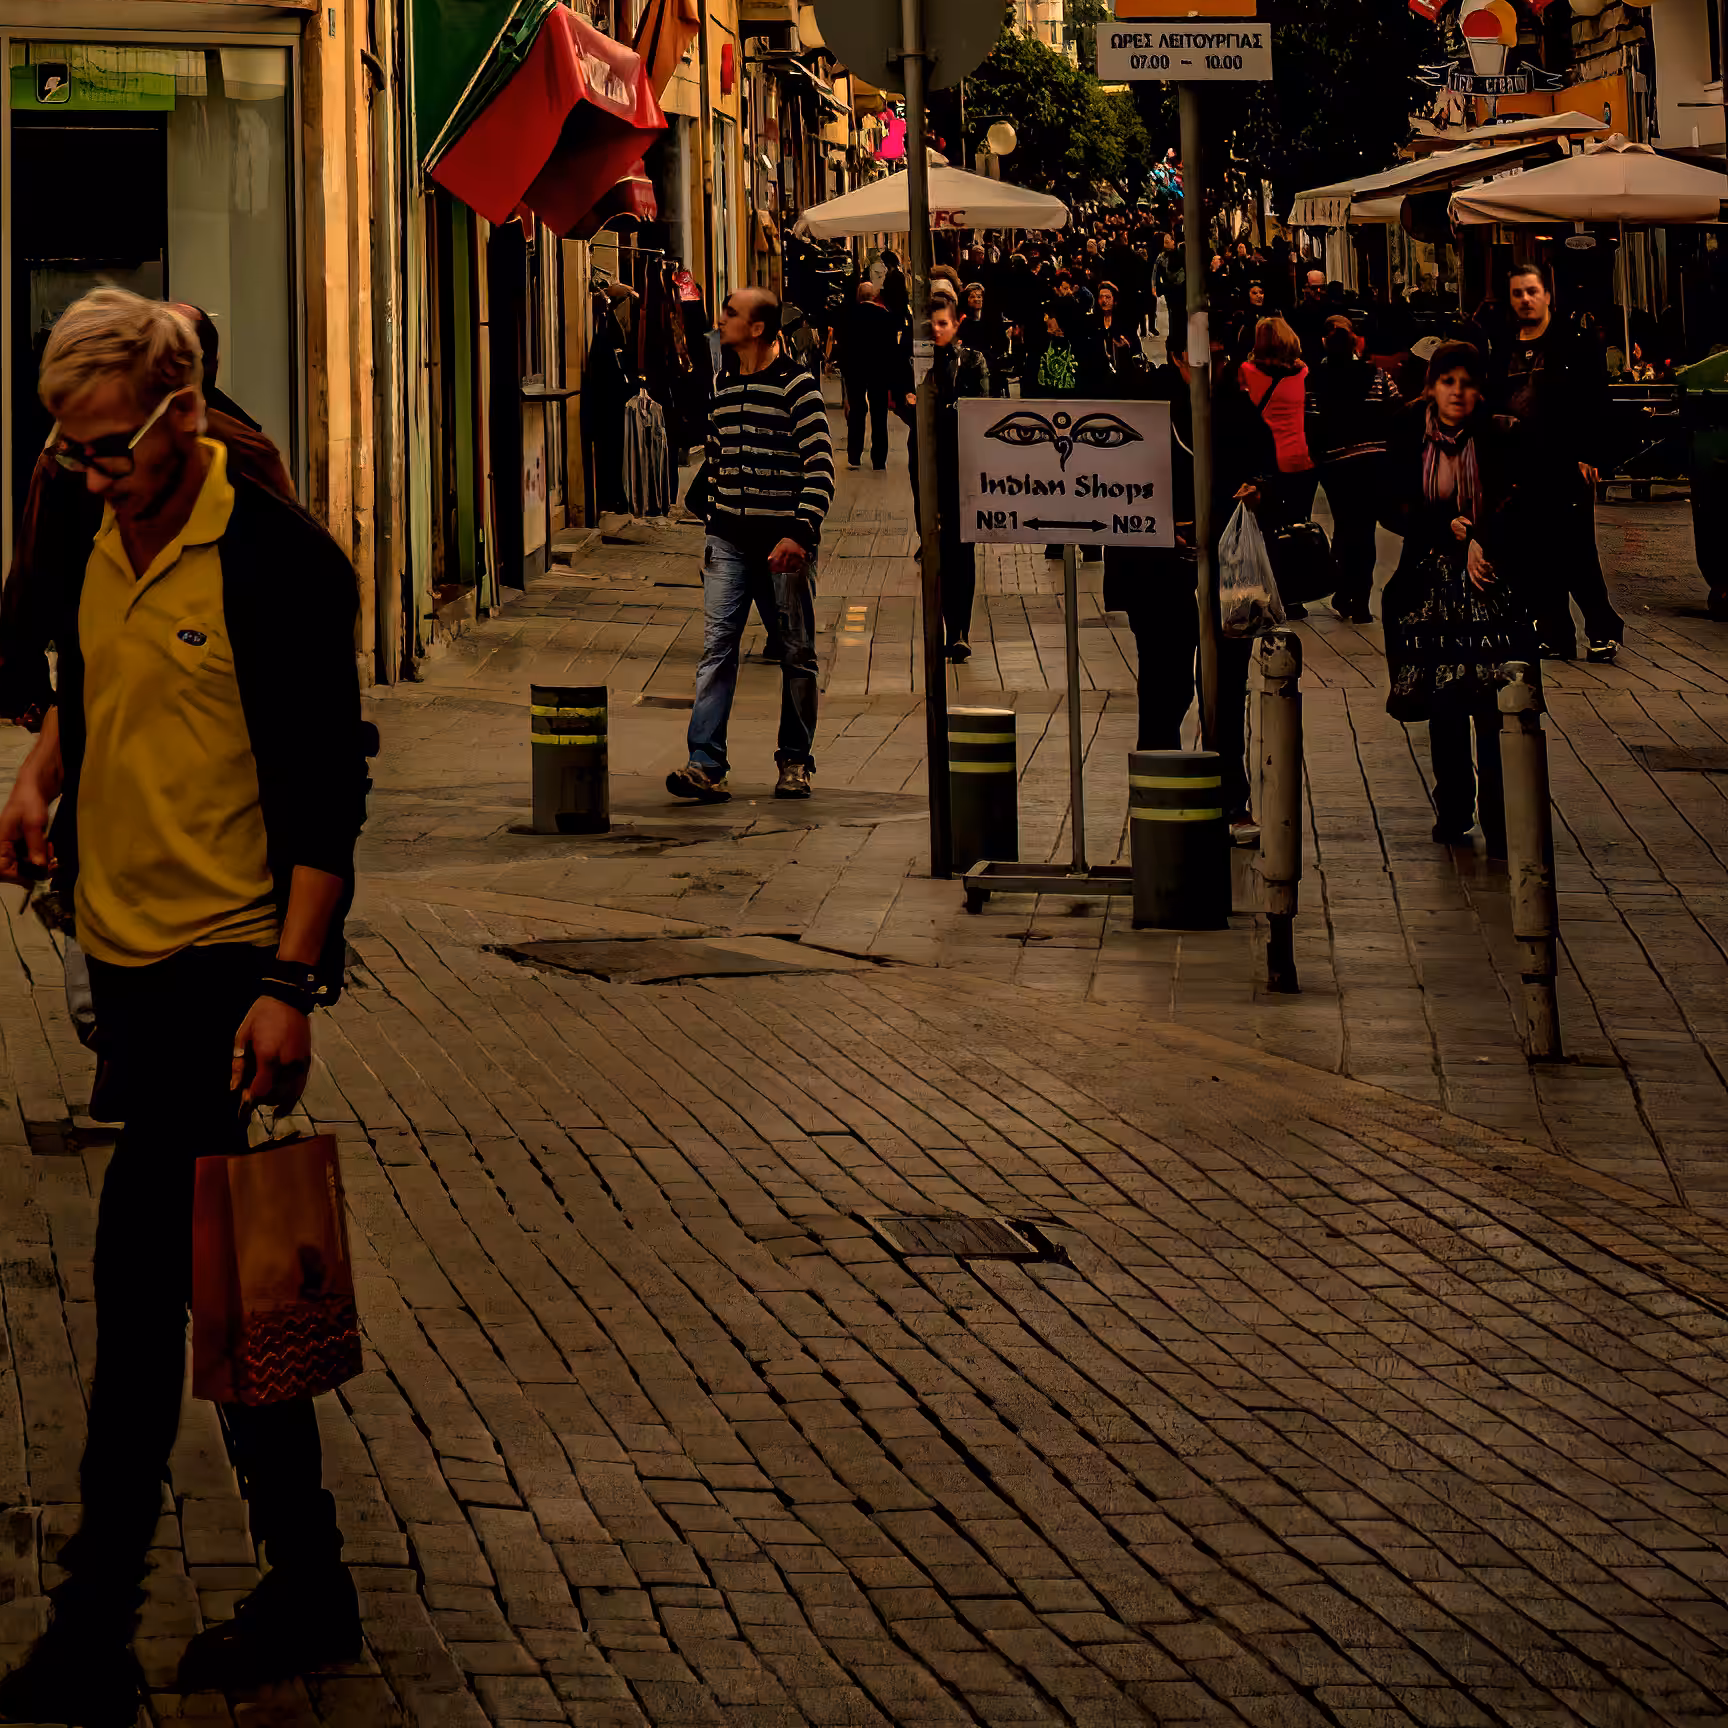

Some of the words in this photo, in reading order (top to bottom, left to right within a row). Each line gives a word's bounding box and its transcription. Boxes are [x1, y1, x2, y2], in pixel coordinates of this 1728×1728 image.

[1110, 33, 1154, 50] ΩΡΕΣ
[1158, 33, 1263, 50] ΛΕΙΤΟΥΡΓΙΑΣ
[1130, 54, 1170, 70] 07.00
[1205, 54, 1243, 70] 10.00
[928, 209, 967, 228] FC
[980, 471, 1066, 496] Indian
[1074, 473, 1154, 505] Shops
